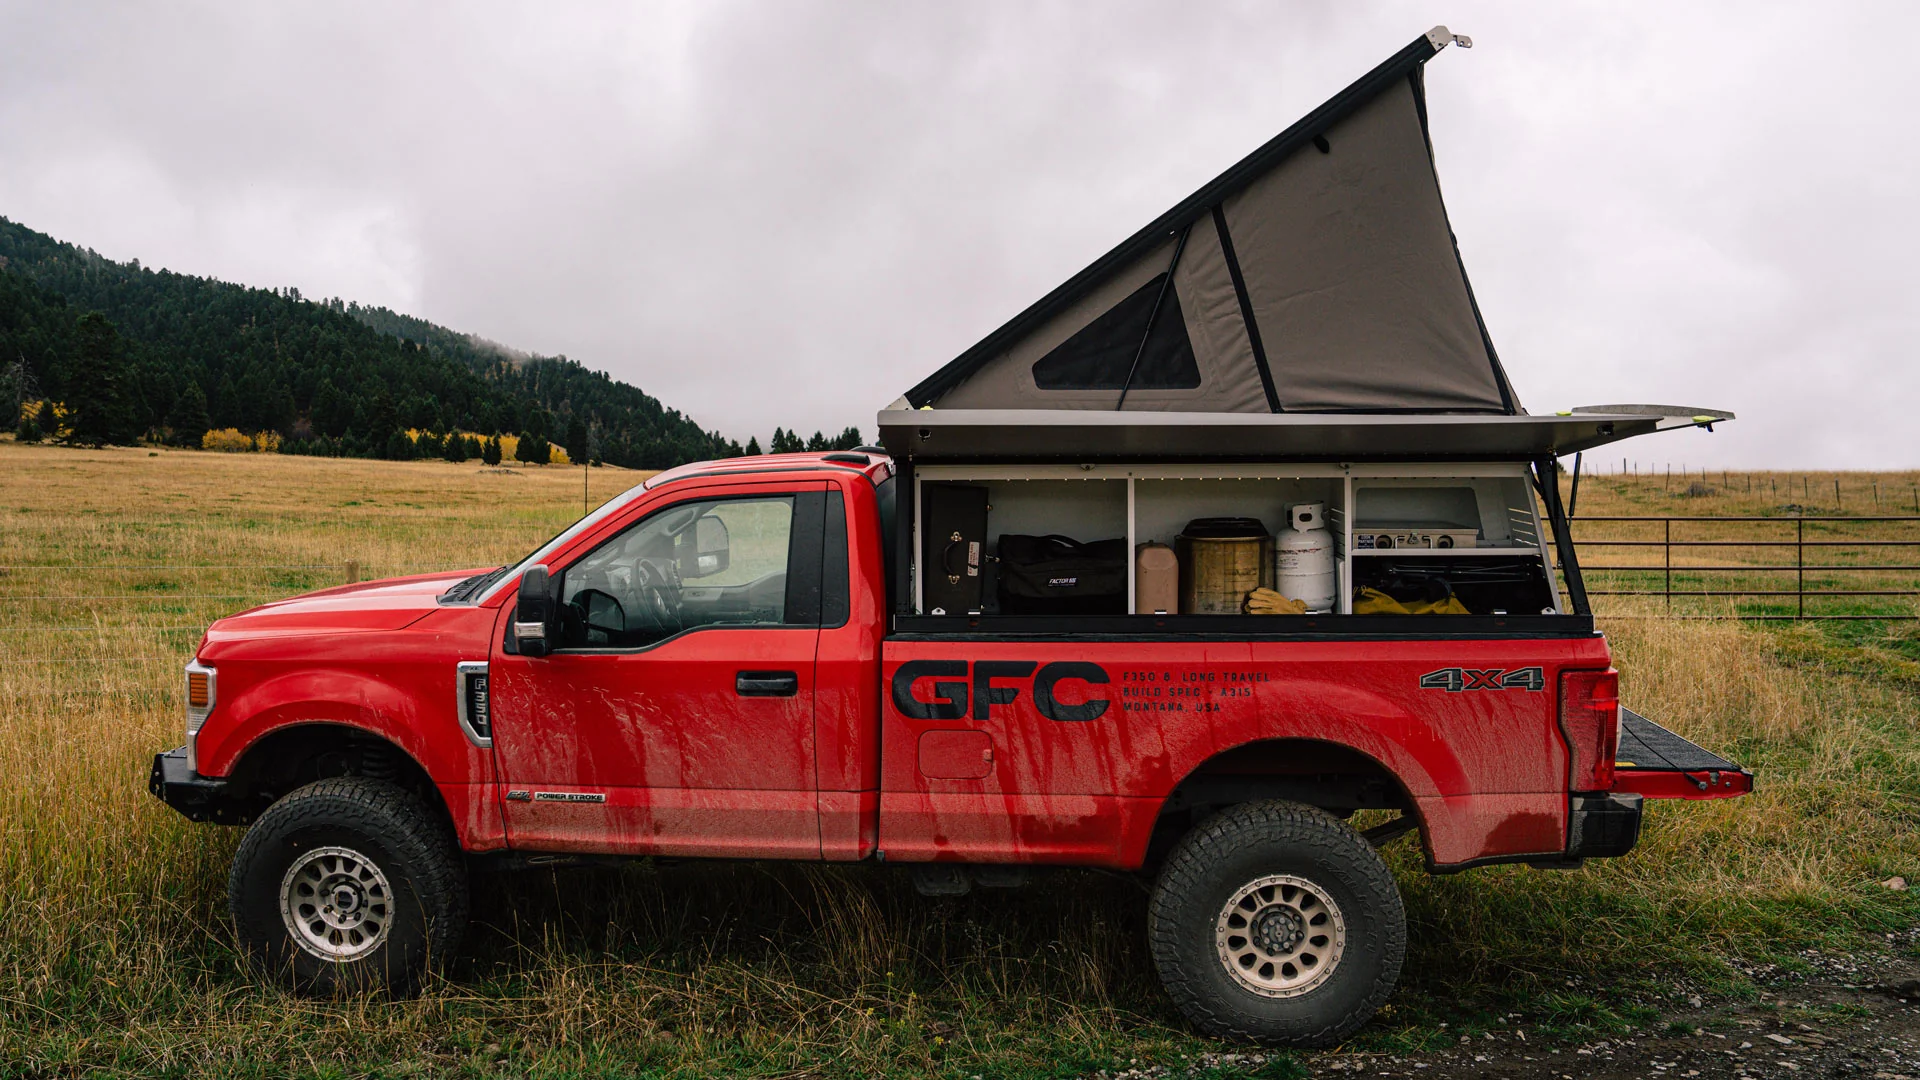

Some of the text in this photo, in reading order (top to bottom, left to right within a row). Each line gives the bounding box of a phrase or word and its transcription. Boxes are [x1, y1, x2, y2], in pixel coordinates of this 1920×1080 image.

[1123, 671, 1156, 682] F350
[1182, 672, 1215, 682] LONG
[1223, 672, 1270, 682] TRAVEL
[892, 659, 1111, 721] GFC
[1123, 687, 1161, 697] BUILD
[1169, 687, 1200, 697] SPEC
[1220, 687, 1251, 697] A315
[1195, 702, 1221, 712] USA
[536, 792, 566, 800] POWER
